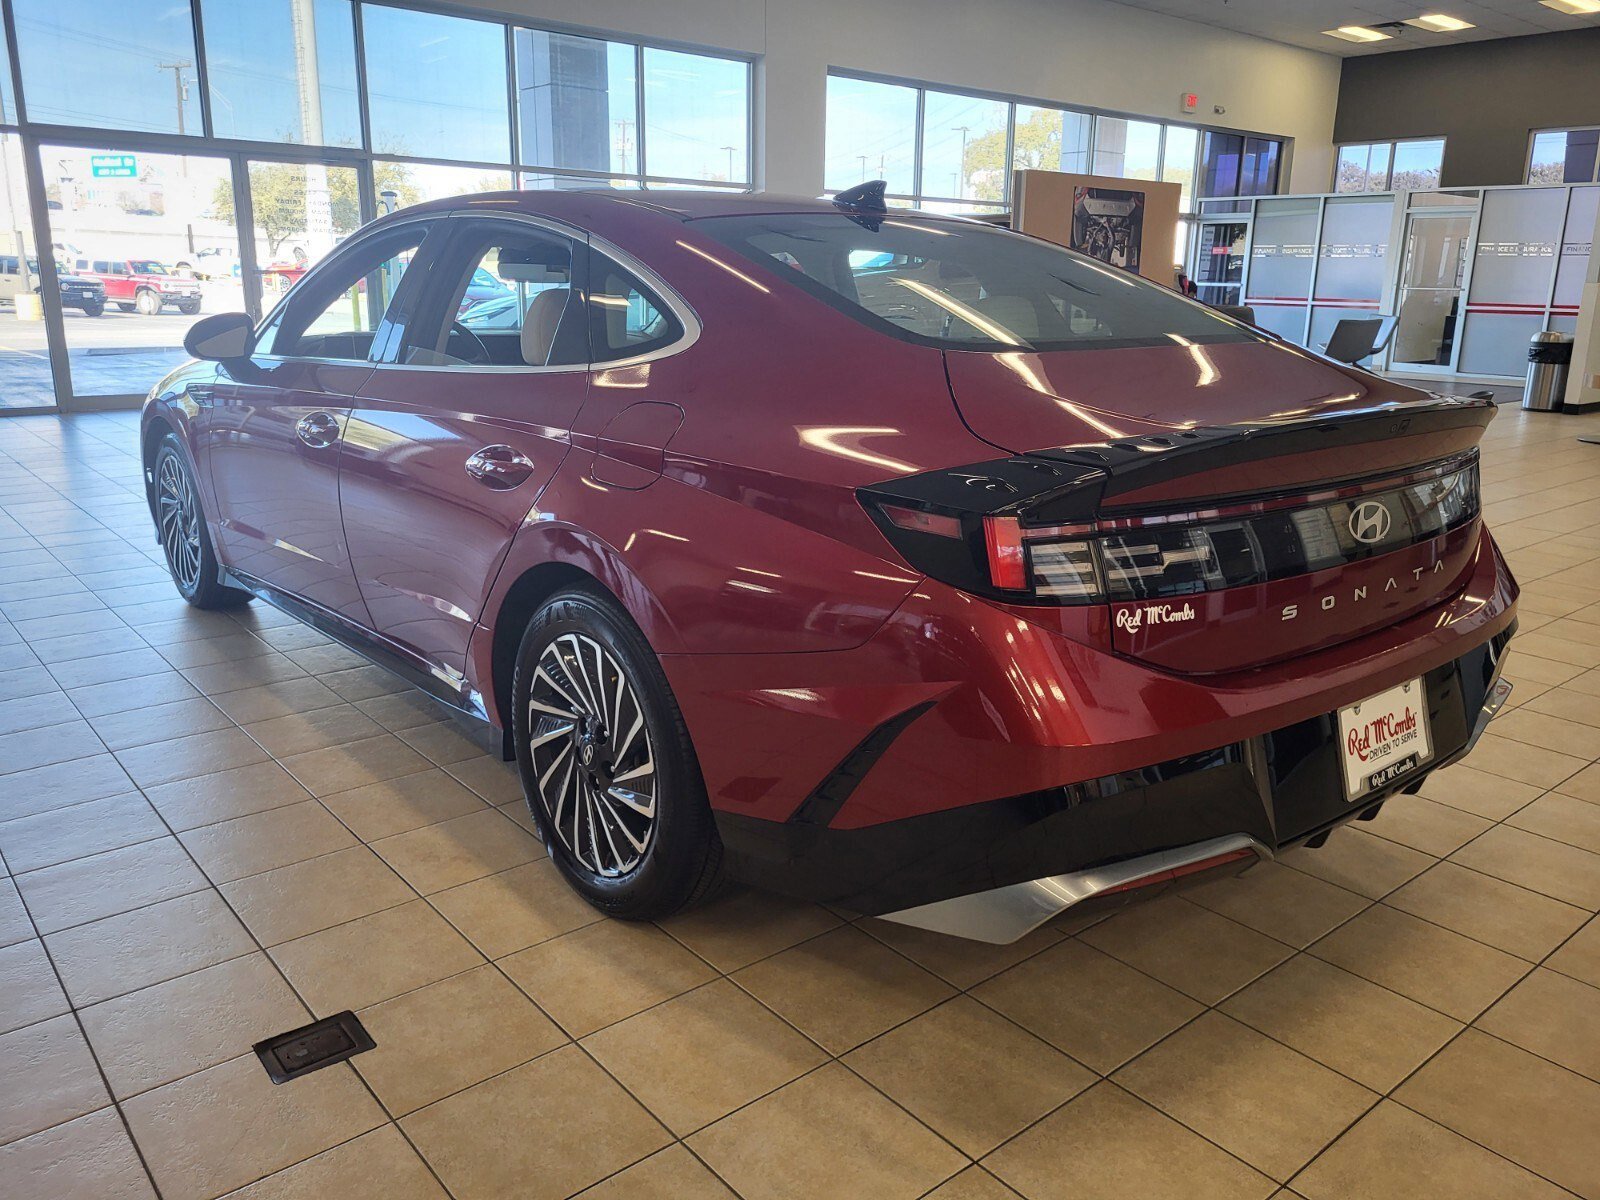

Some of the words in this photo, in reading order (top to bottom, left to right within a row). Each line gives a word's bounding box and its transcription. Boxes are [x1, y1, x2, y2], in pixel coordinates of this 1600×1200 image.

[1281, 560, 1444, 621] SONATA
[1116, 608, 1142, 634] Red
[1143, 602, 1195, 625] McCombs
[1347, 725, 1371, 761] Red
[1371, 706, 1417, 744] McCombs
[1369, 742, 1391, 760] DRIVEN
[1392, 738, 1400, 748] TO
[1401, 729, 1418, 744] SERVE
[1371, 772, 1386, 787] Red
